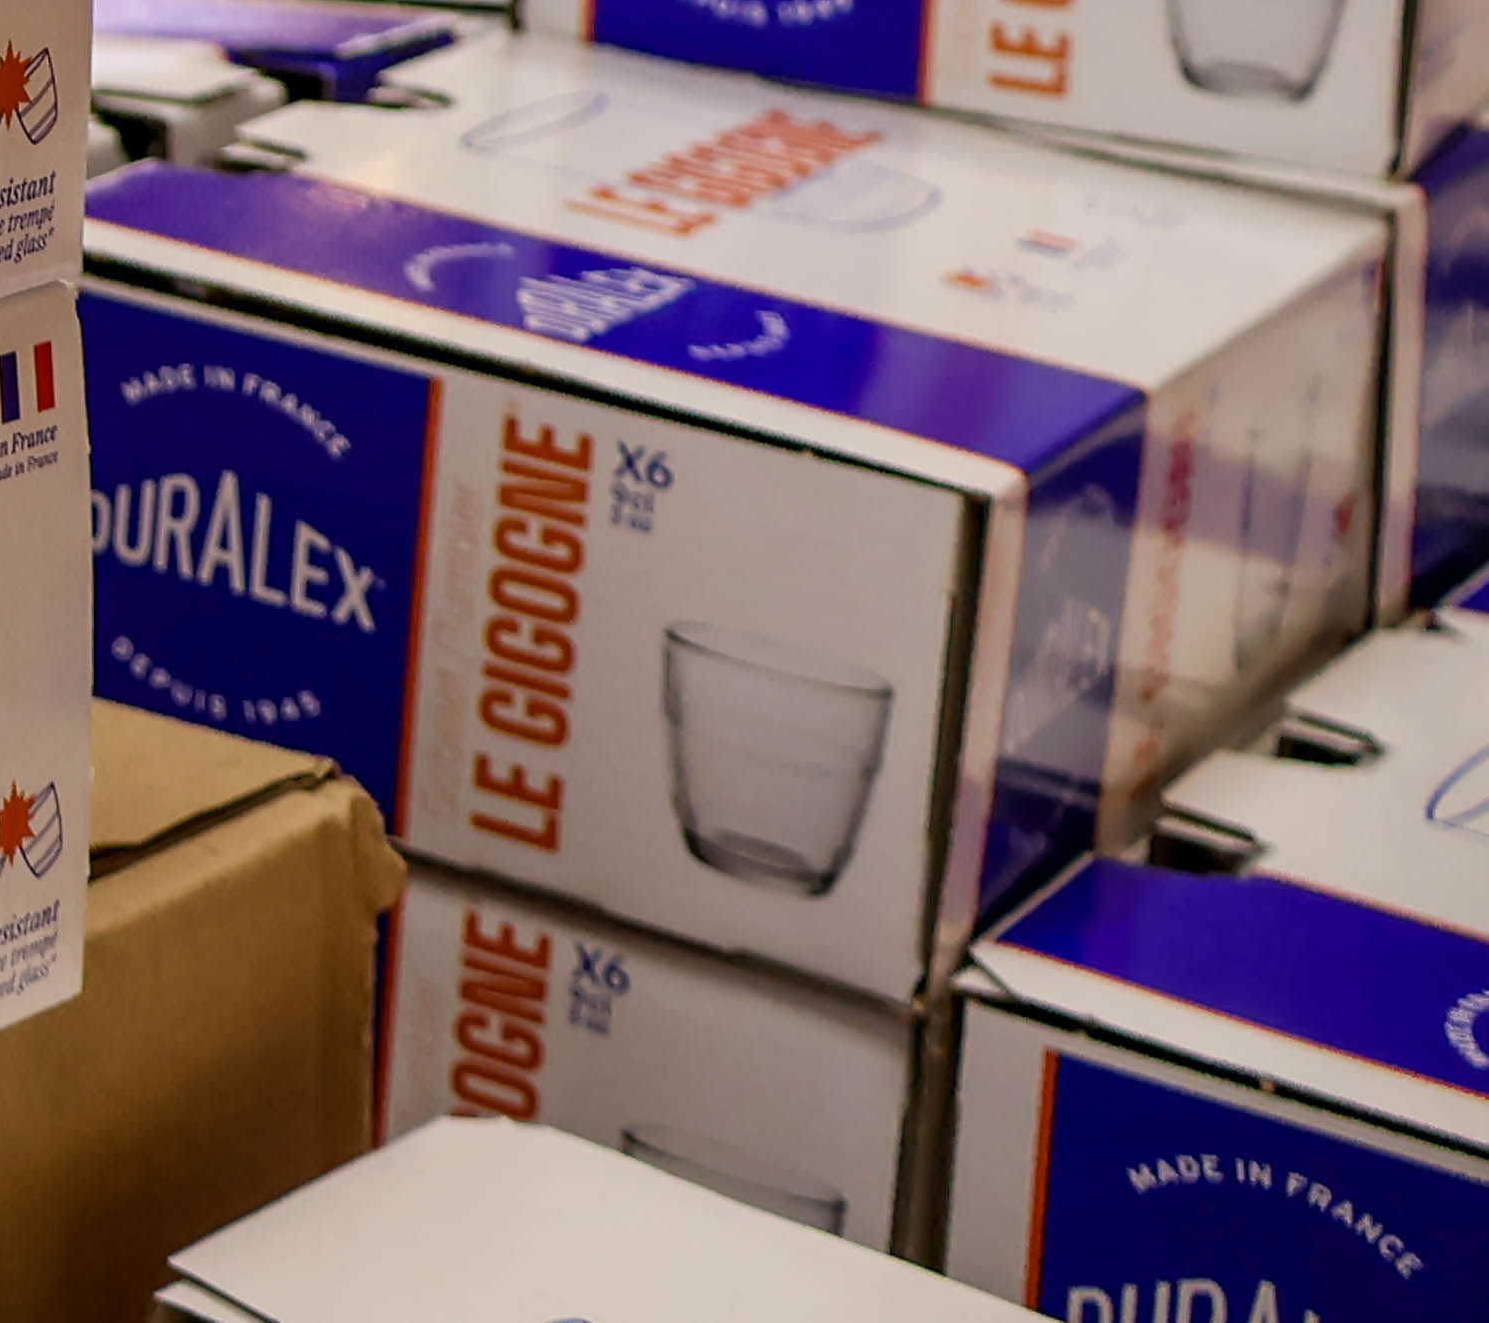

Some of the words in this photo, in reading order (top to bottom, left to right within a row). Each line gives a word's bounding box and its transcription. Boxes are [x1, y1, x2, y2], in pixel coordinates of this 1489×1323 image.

[988, 21, 1073, 99] LE
[120, 362, 196, 406] MADE
[203, 365, 236, 390] IN
[242, 372, 351, 460] FRANCE
[615, 438, 674, 490] X6
[470, 751, 563, 853] LE
[1126, 1154, 1224, 1193] MADE
[1236, 1158, 1272, 1191] IN
[1286, 1171, 1424, 1279] FRANCE
